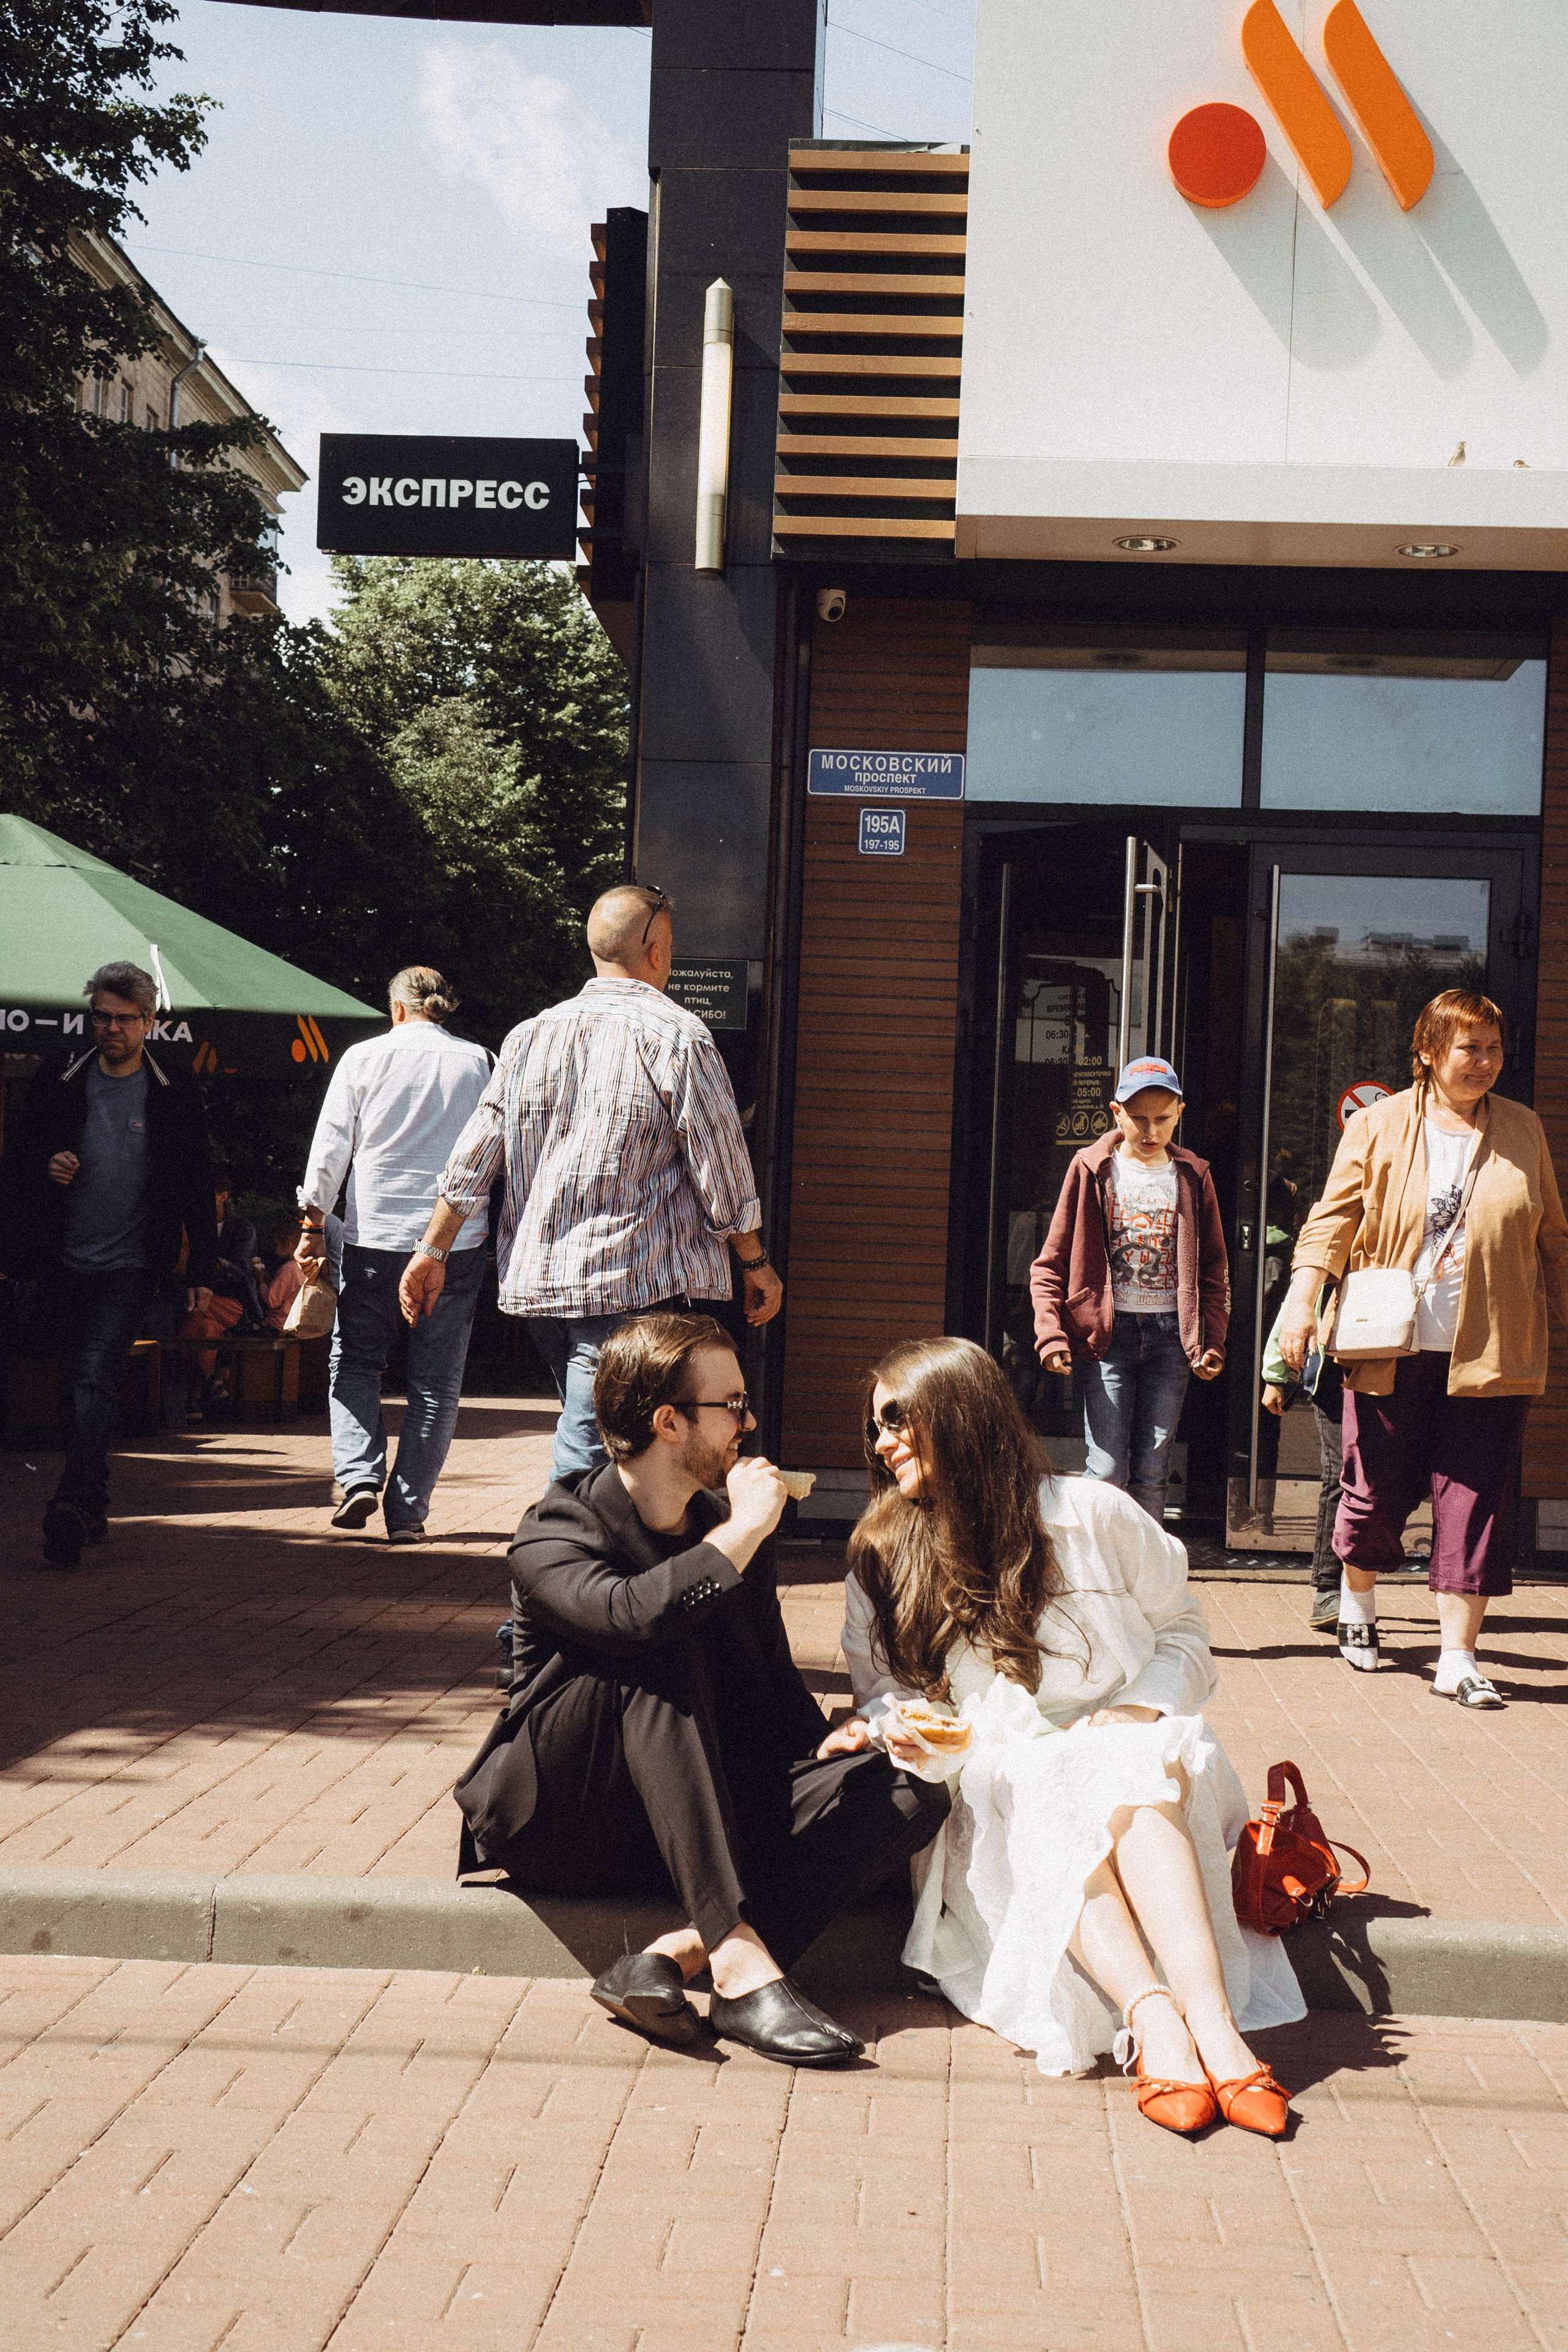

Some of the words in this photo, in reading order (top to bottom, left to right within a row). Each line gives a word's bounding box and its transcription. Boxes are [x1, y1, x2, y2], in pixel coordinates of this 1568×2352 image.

[342, 476, 550, 510] ЭКСПРЕСС
[821, 754, 952, 773] МОСКОВСКИЙ
[854, 772, 917, 785] проспект
[844, 785, 888, 793] MOSKOVSKIY
[864, 815, 900, 834] 195А
[864, 839, 900, 851] 197-195
[684, 984, 730, 993] кормите
[692, 1009, 726, 1019] СИБО!
[1046, 1029, 1069, 1039] 06:30
[1077, 1087, 1101, 1097] 05:00
